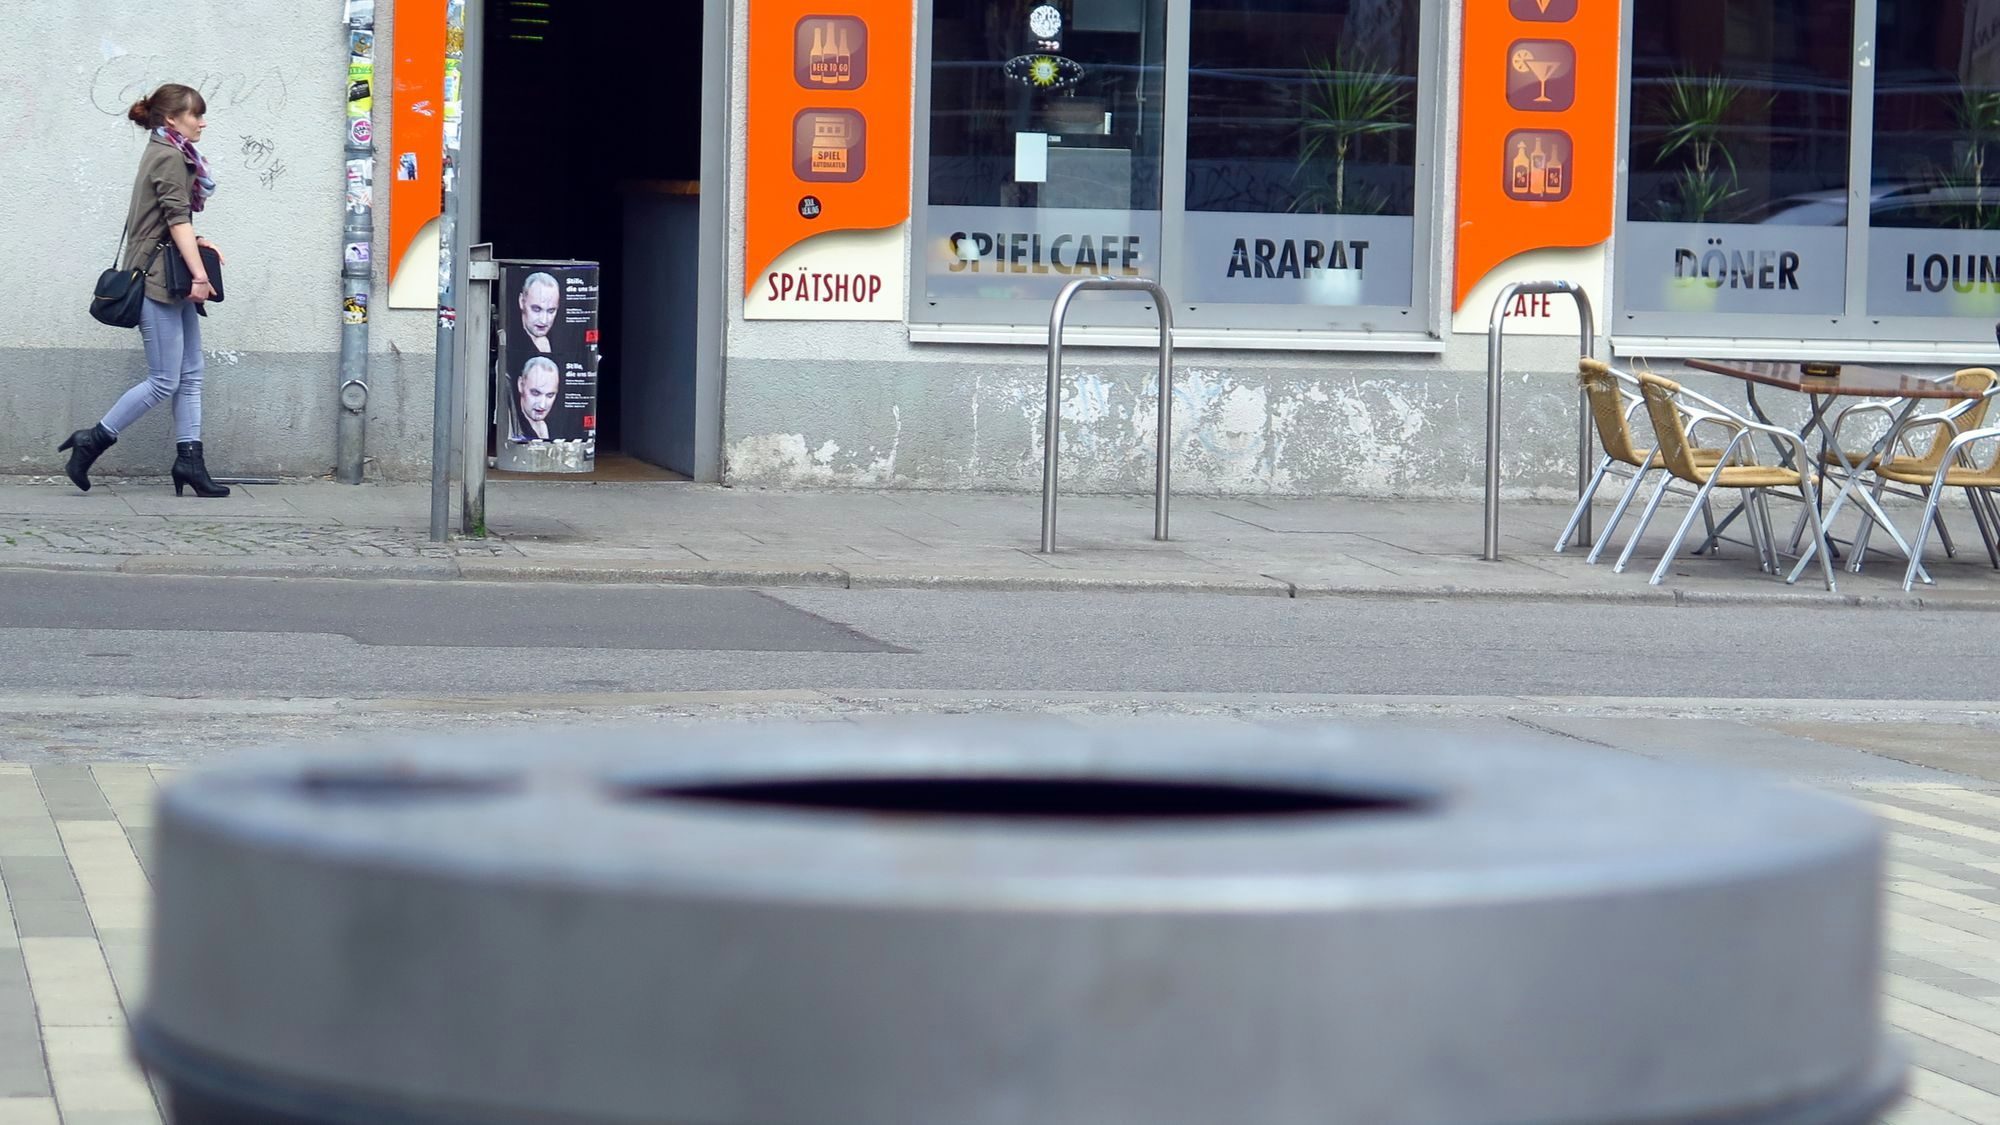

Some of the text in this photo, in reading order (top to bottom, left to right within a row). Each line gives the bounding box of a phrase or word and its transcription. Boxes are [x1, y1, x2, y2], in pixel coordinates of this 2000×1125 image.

[812, 63, 848, 72] BEER TO GO
[813, 161, 846, 169] AUTOMATEN
[817, 151, 841, 160] SPIEL
[948, 231, 1140, 276] SPIELCAFE
[1226, 237, 1369, 280] ARARAT
[1674, 238, 1800, 290] DÖNER
[1906, 252, 2000, 294] LOUN
[768, 267, 882, 303] SPÄTSHOP
